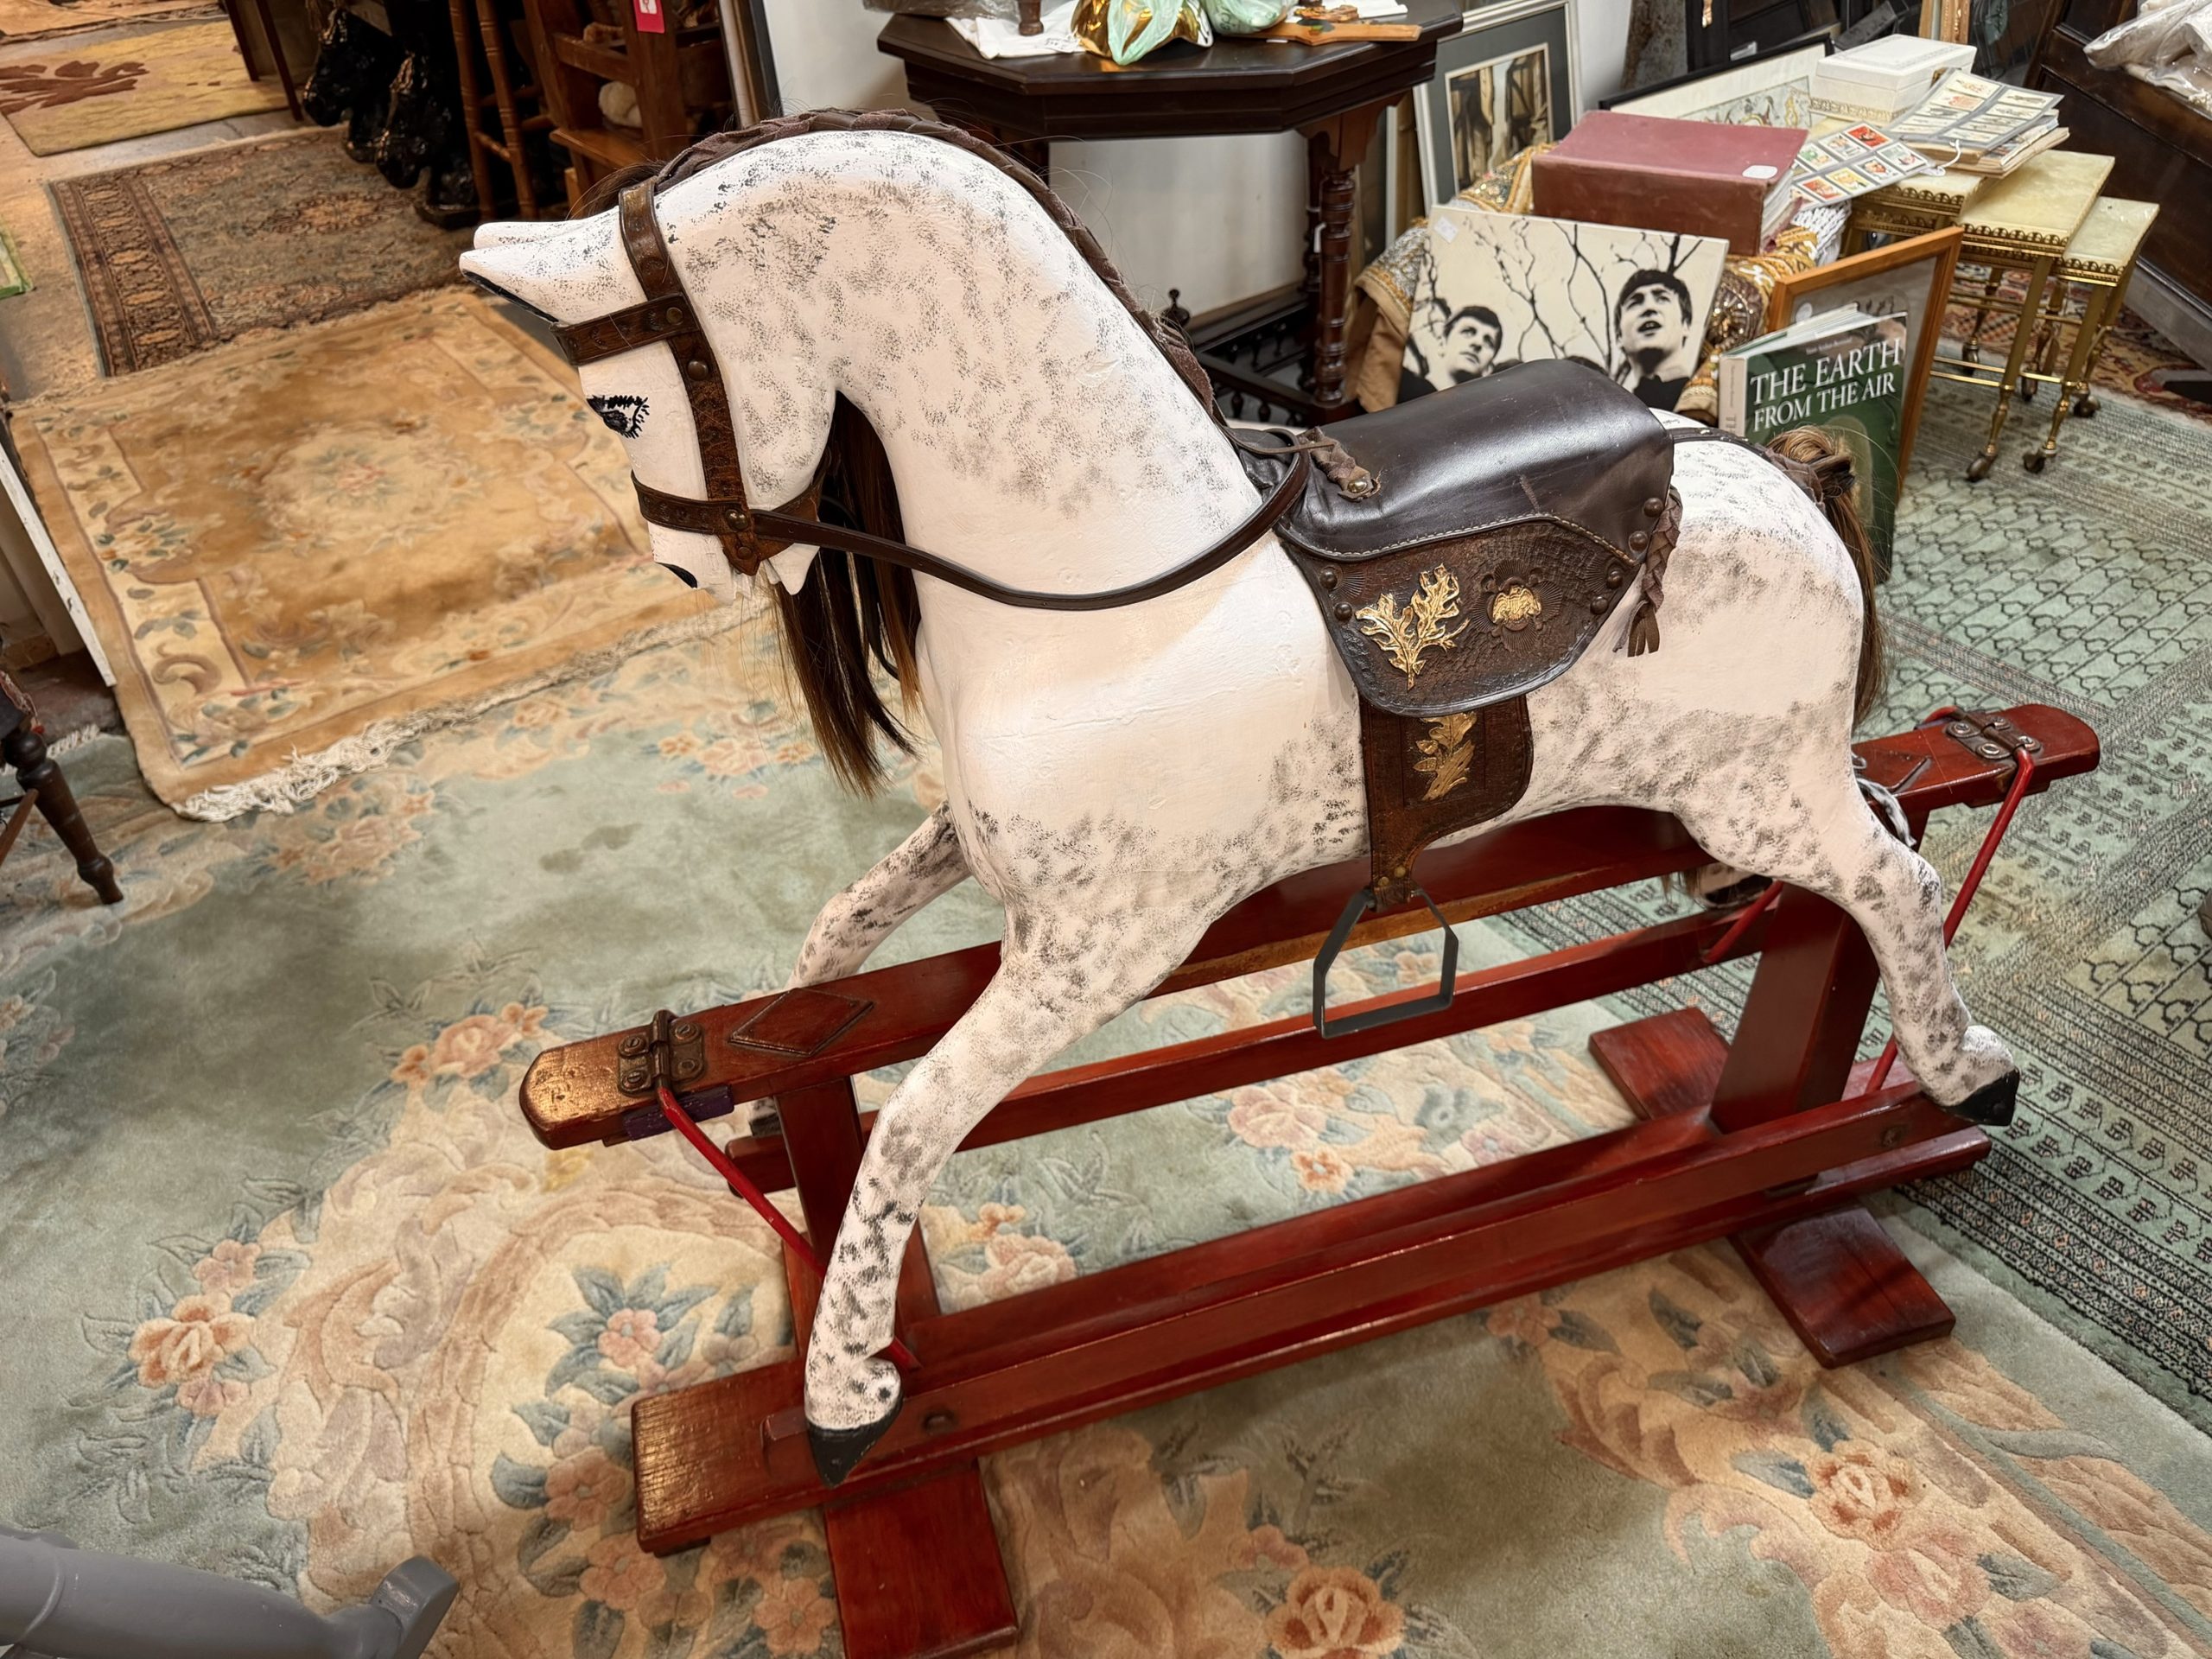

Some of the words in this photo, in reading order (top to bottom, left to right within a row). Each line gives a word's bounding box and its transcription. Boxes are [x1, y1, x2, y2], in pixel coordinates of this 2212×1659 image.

[1750, 363, 1807, 405] THE
[1815, 338, 1901, 388] EARTH
[1754, 394, 1812, 432] FROM
[1817, 381, 1859, 413] THE
[1861, 372, 1896, 401] AIR
